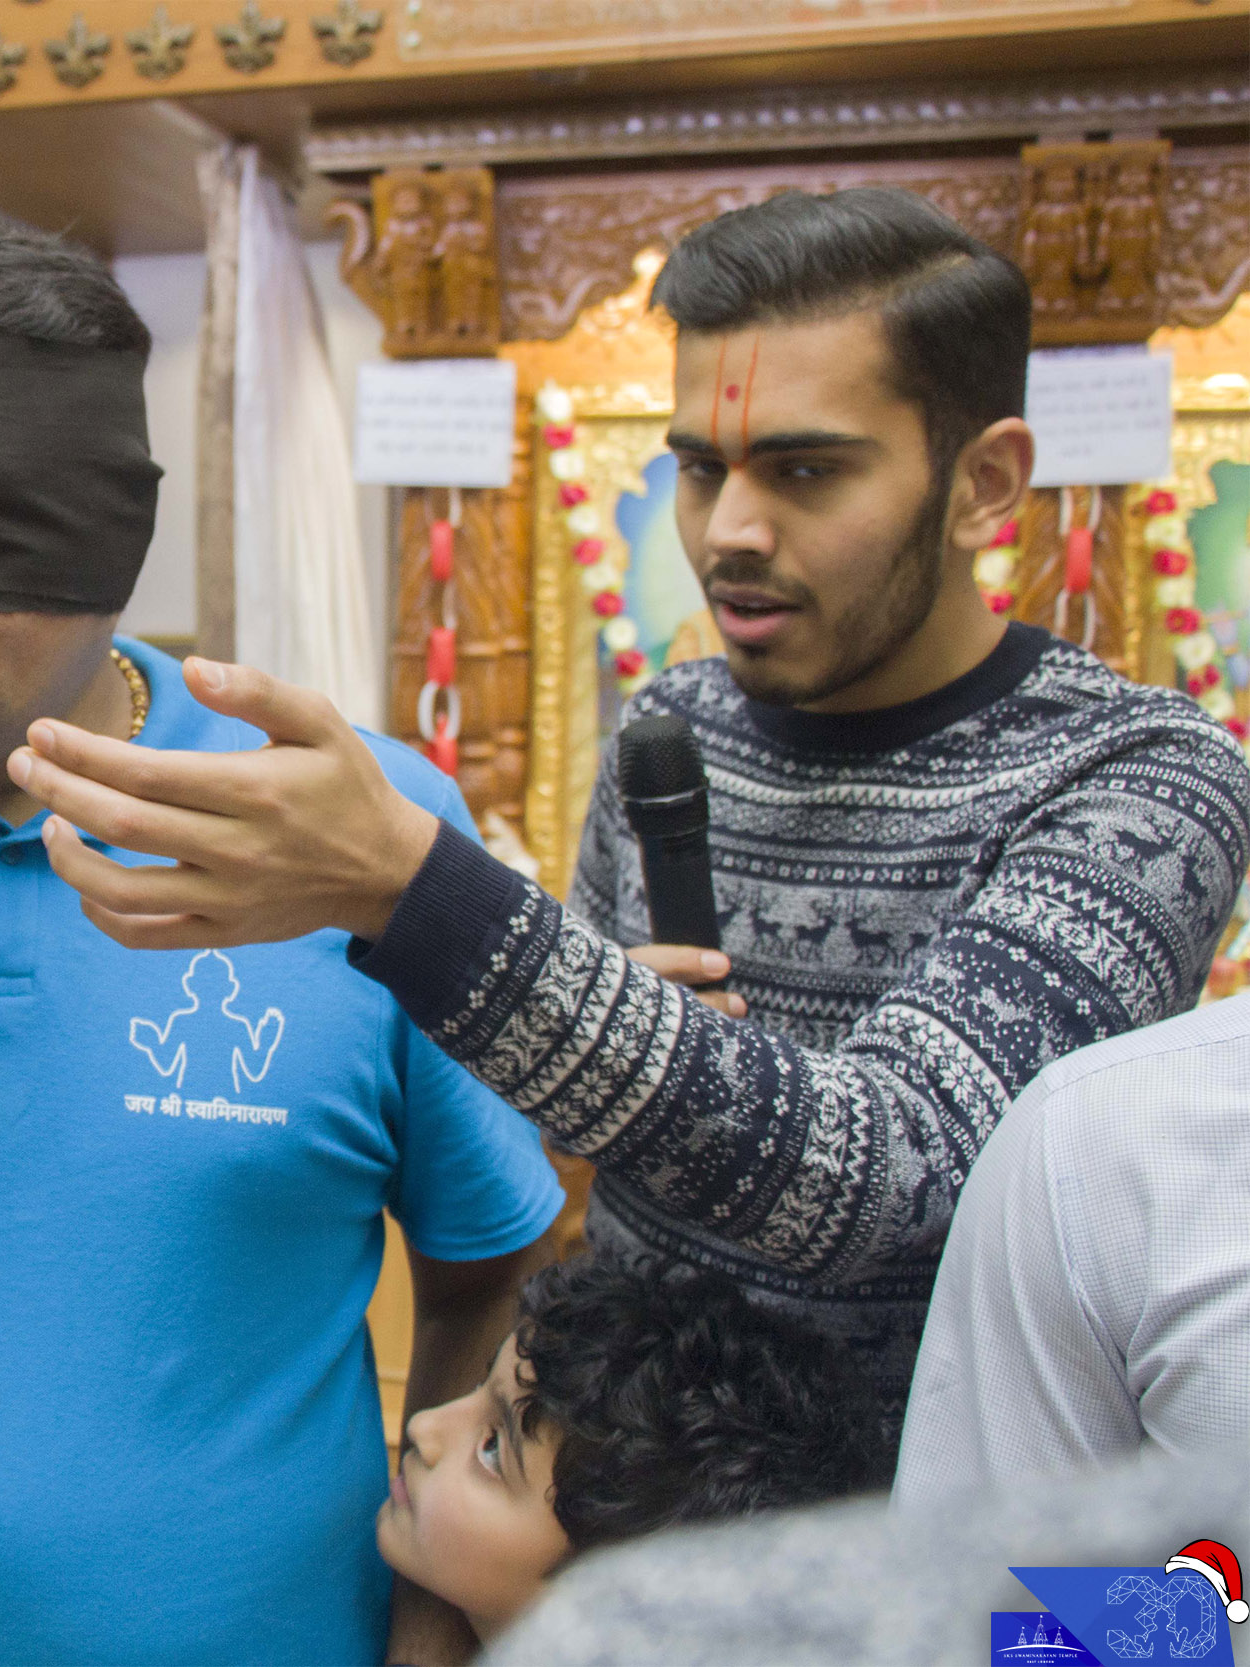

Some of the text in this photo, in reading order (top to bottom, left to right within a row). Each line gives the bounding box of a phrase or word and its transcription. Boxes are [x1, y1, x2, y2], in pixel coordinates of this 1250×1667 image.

[124, 1092, 288, 1126] जय श्री स्वामिनारायण
